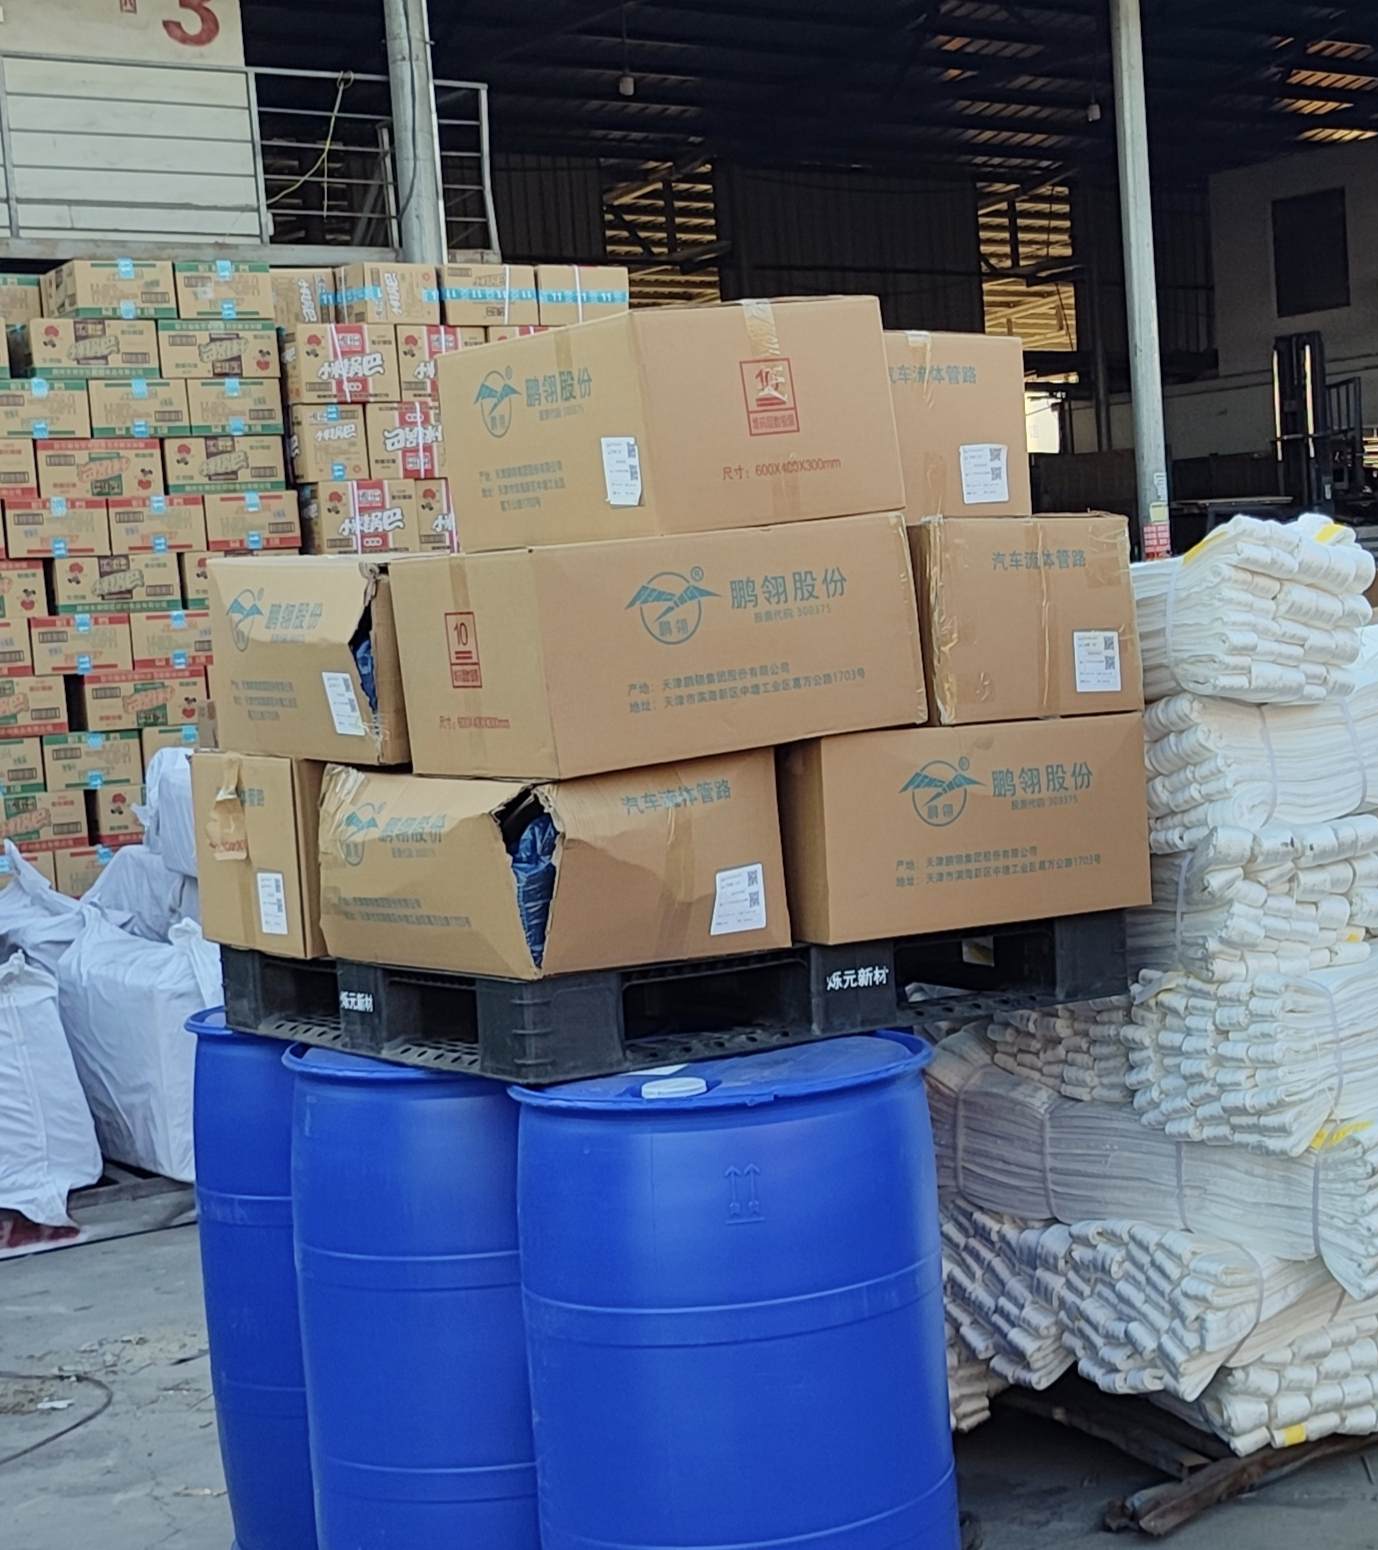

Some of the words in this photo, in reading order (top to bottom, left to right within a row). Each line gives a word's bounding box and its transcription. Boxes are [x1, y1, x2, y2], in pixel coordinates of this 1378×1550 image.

[992, 550, 1086, 571] 汽车流体管路
[729, 567, 848, 610] 鹏翎股份
[453, 621, 469, 646] 10
[991, 760, 1094, 798] 鹏翎股份
[826, 965, 889, 991] 烁元新材
